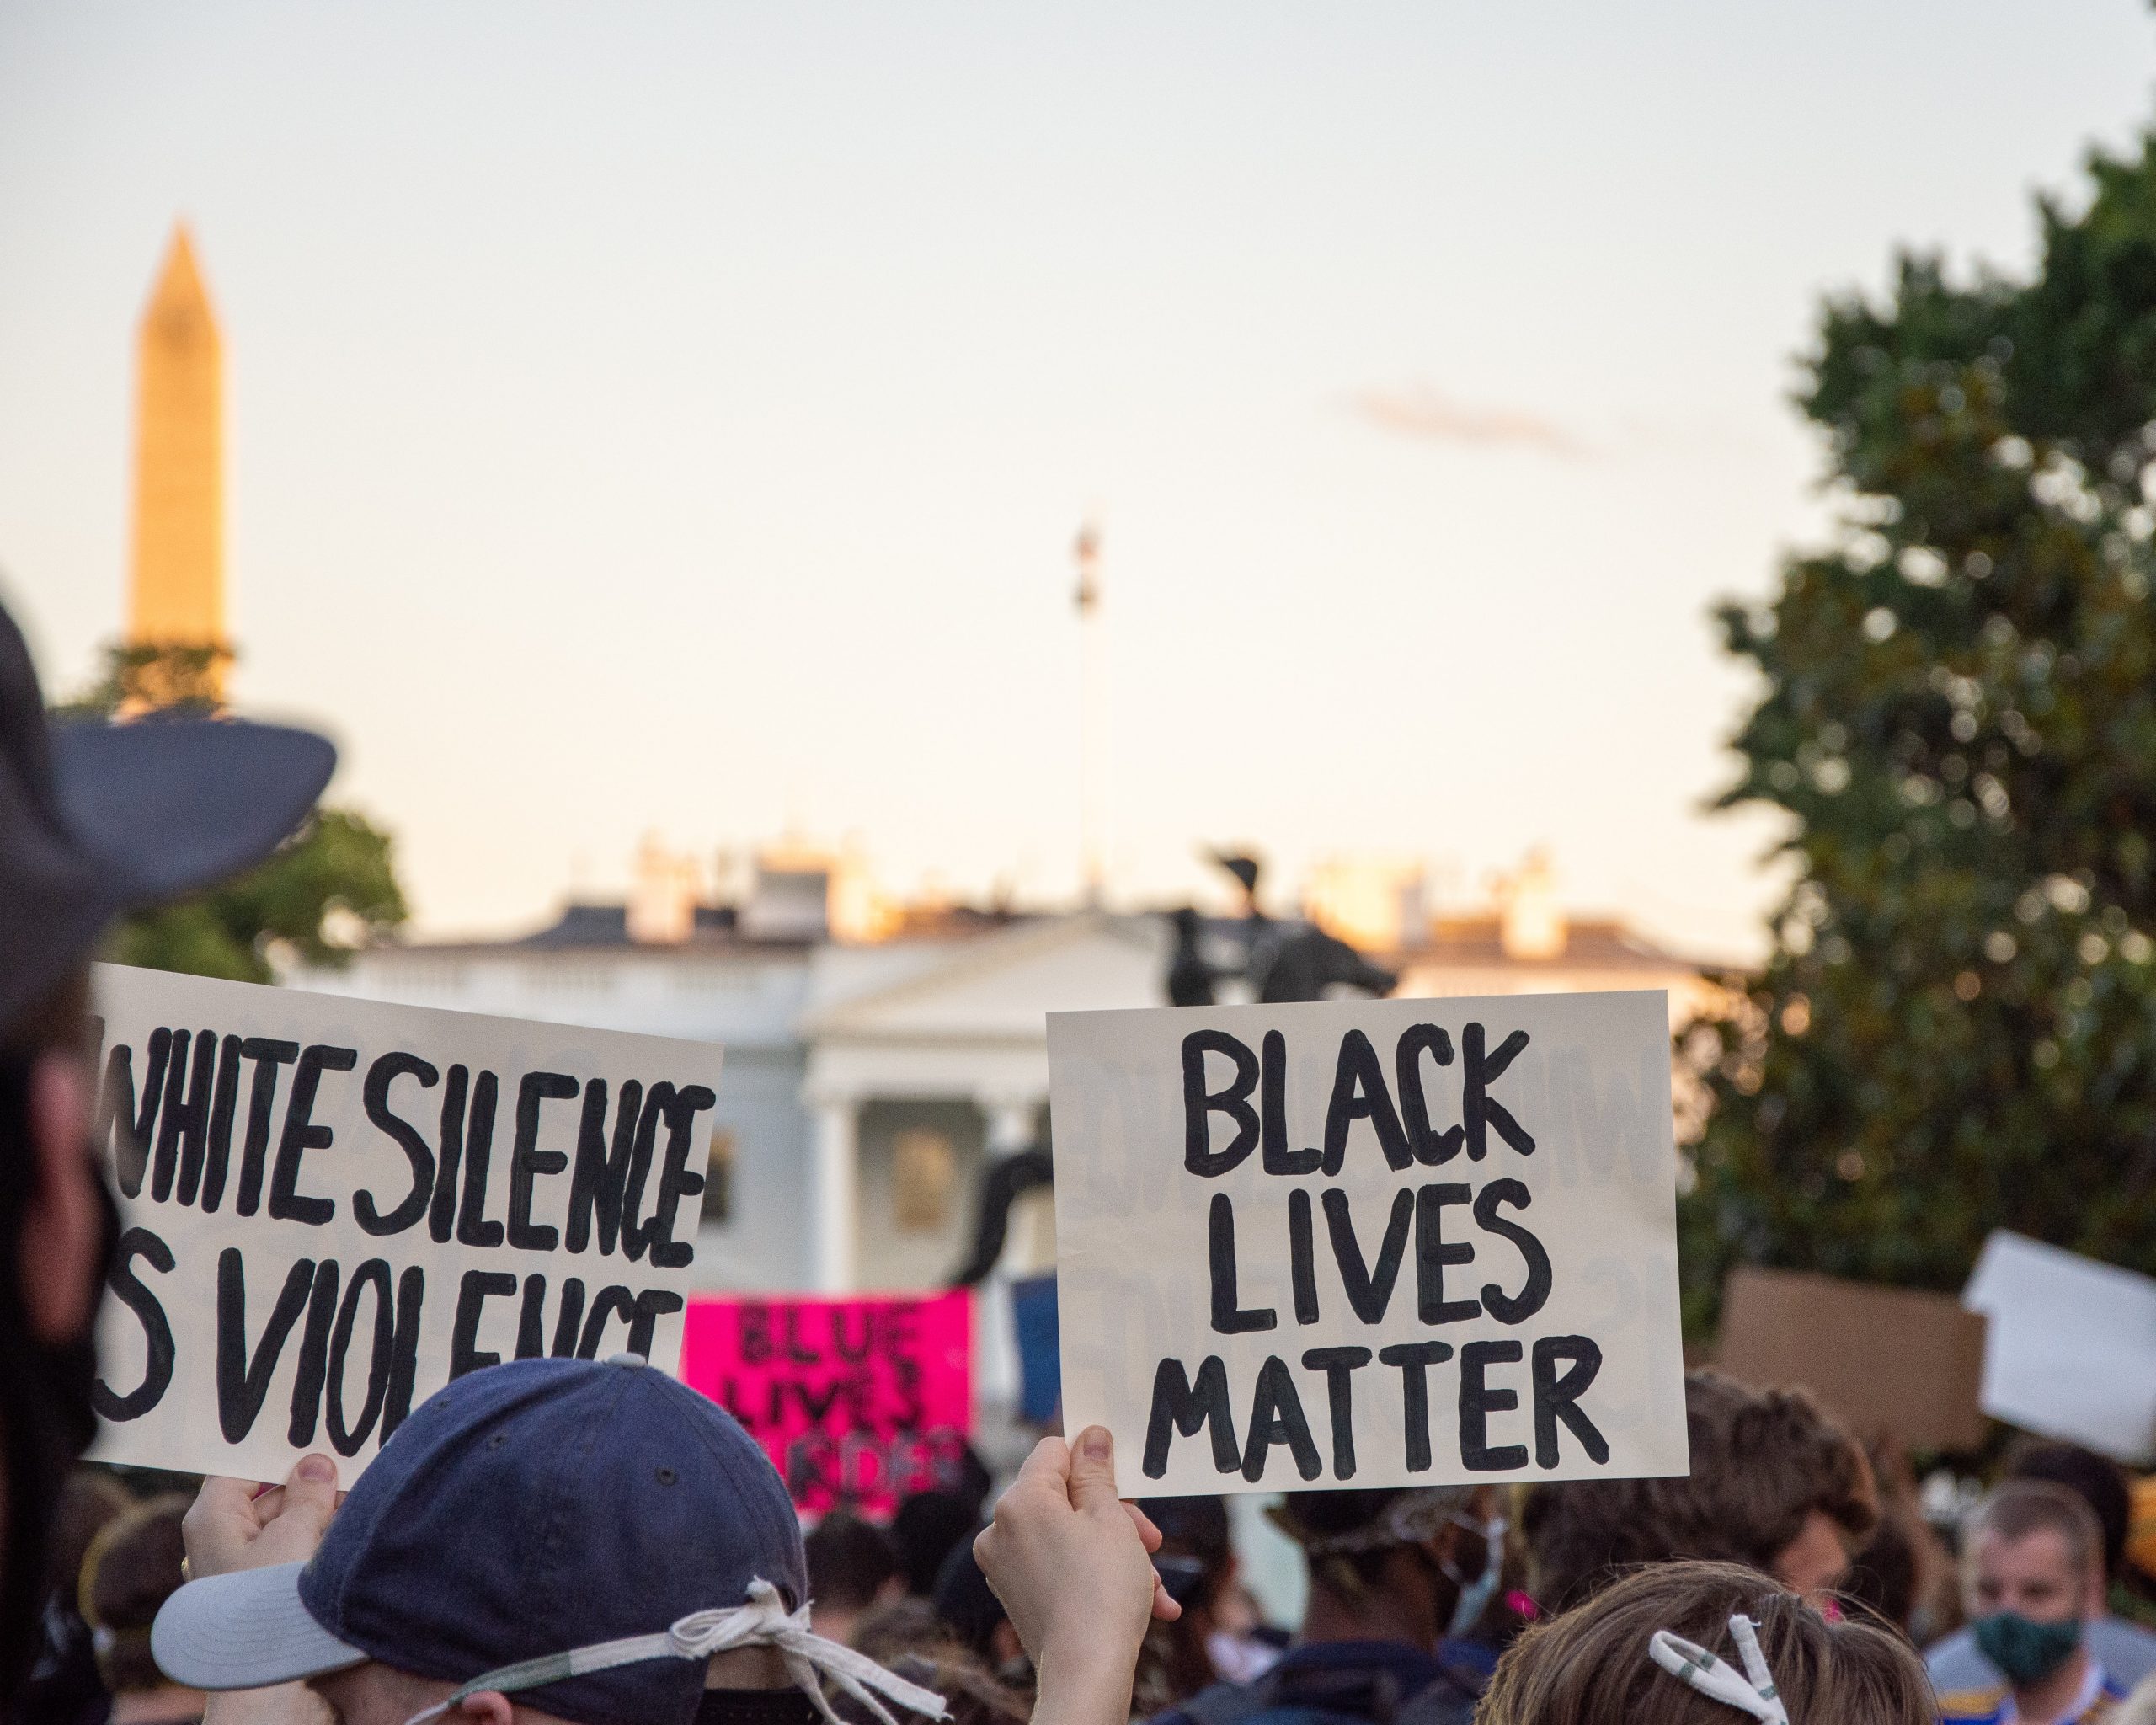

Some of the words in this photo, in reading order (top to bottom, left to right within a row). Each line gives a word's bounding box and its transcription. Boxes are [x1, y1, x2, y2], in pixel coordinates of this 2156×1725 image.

[91, 1016, 357, 1226] WHITE
[352, 1051, 716, 1268] SILENCE
[1181, 1022, 1536, 1178] BLACK
[92, 1227, 175, 1422] S
[737, 1300, 920, 1365] BLUE
[1208, 1178, 1552, 1334] LIVES
[722, 1355, 924, 1437] LIVES
[1142, 1335, 1609, 1483] MATTER
